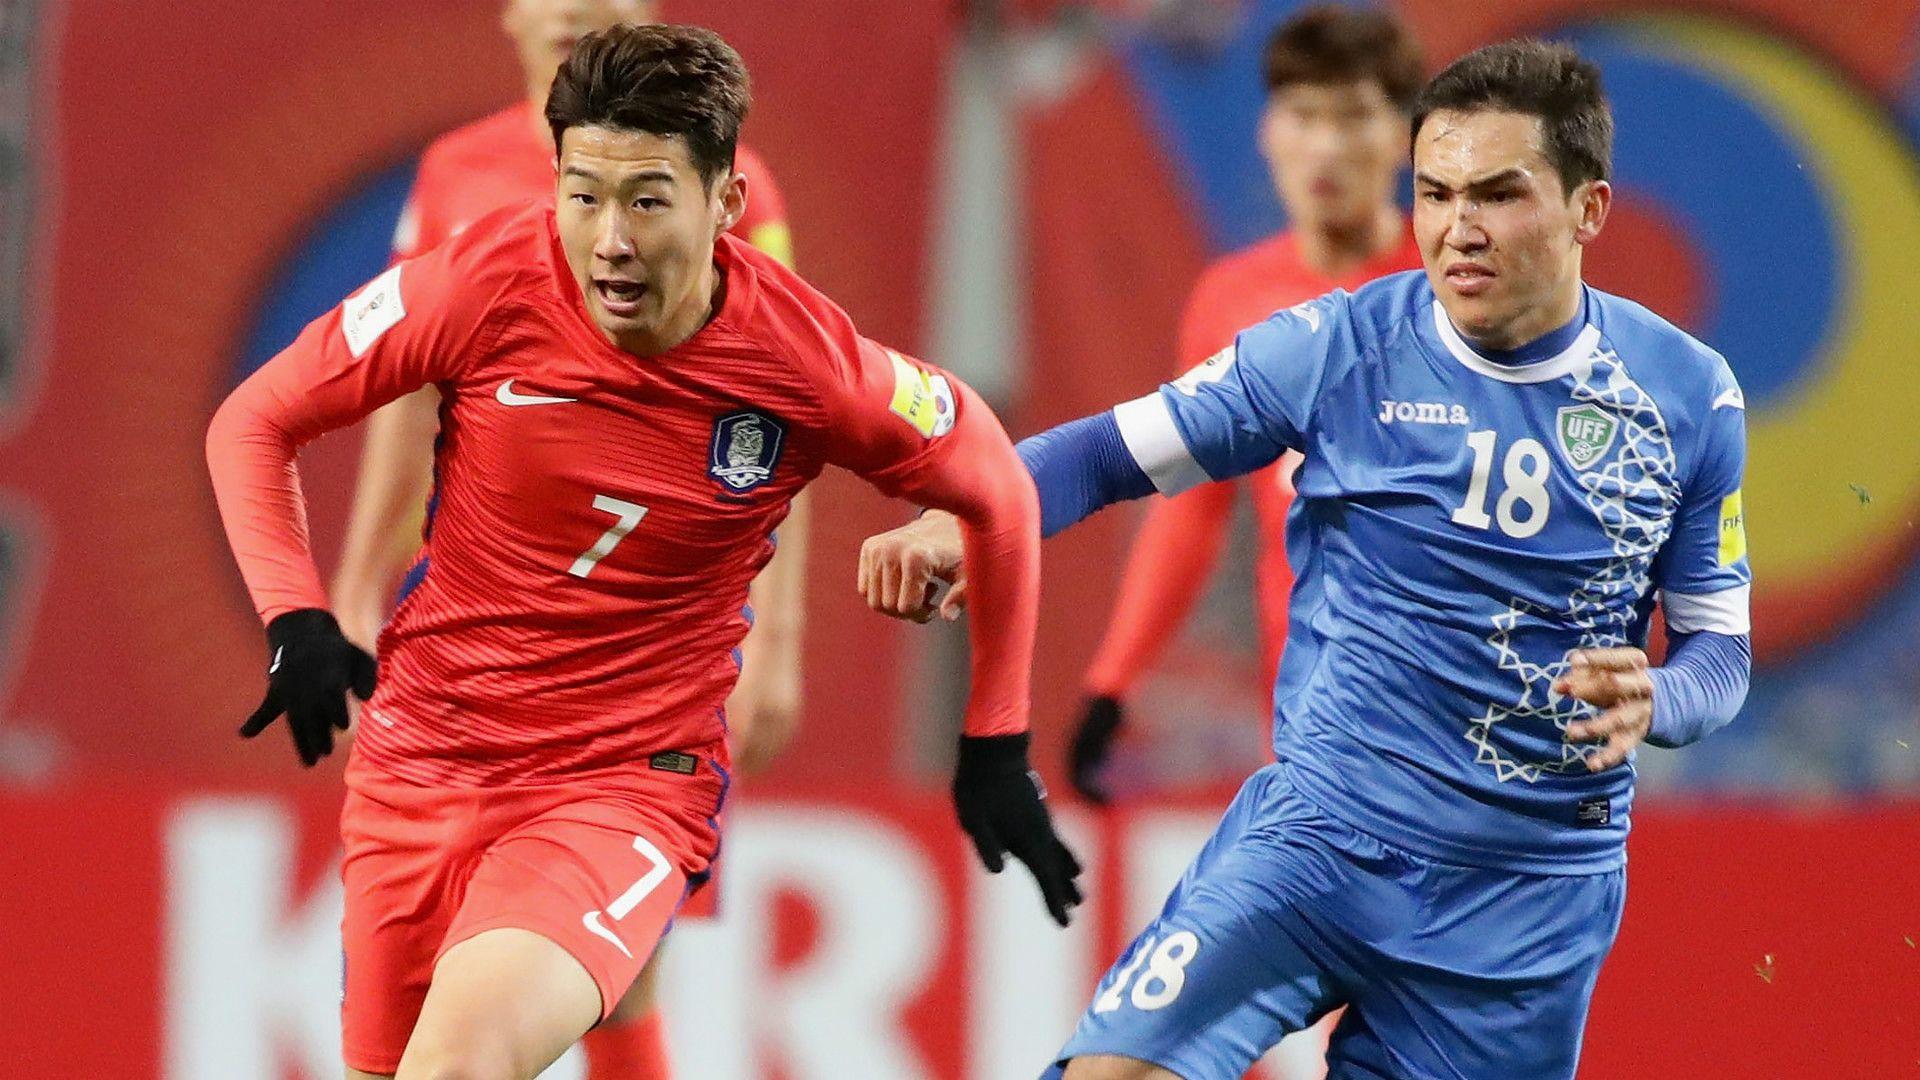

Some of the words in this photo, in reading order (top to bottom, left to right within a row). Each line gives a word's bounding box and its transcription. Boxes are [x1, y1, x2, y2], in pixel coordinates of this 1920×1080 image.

[1379, 400, 1469, 425] Joma
[1567, 416, 1608, 443] UFF
[1451, 430, 1550, 538] 18
[568, 494, 649, 578] 7
[607, 835, 672, 921] 7
[1093, 931, 1198, 1014] 18
